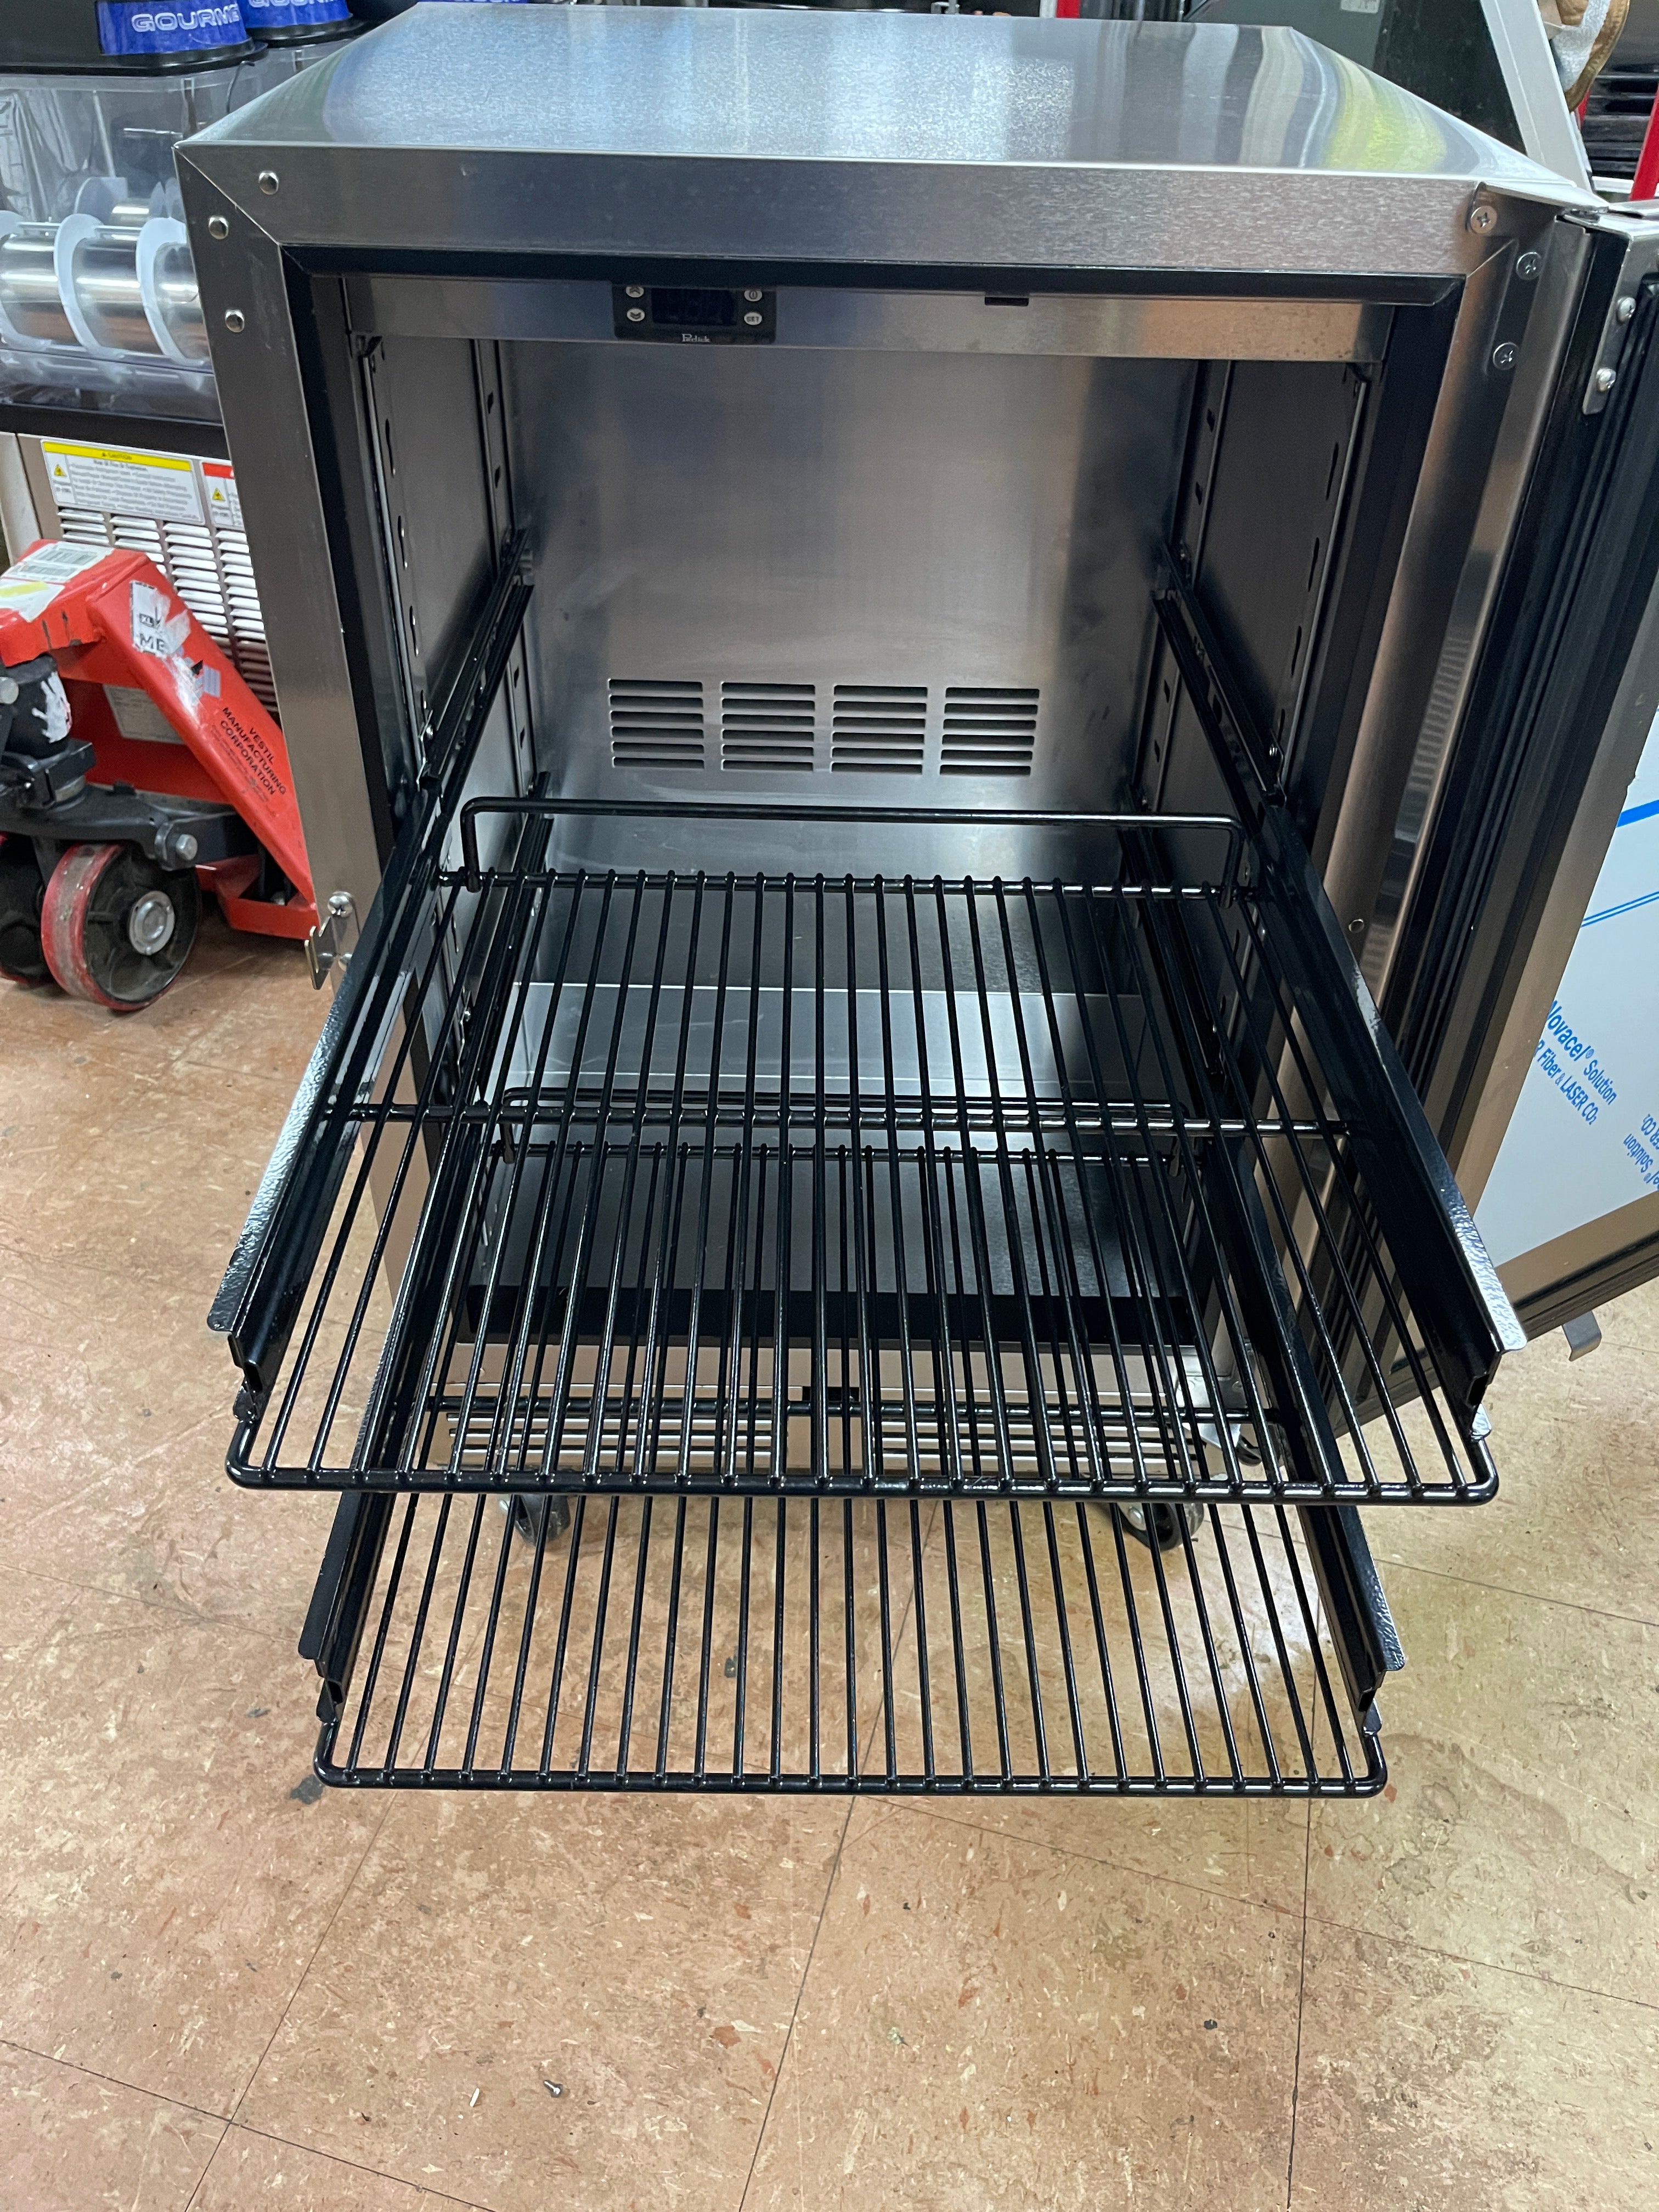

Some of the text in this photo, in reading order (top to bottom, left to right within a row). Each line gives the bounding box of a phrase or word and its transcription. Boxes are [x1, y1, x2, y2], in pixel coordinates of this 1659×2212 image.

[221, 720, 275, 795] CORPORATION
[223, 707, 286, 794] MANUFACTURING
[250, 727, 274, 765] VESTIL
[1537, 1047, 1562, 1079] Fiber
[1555, 1072, 1566, 1086] &
[1583, 1059, 1617, 1105] Solution
[1560, 1075, 1589, 1111] LASER
[1623, 1133, 1654, 1173] Solution
